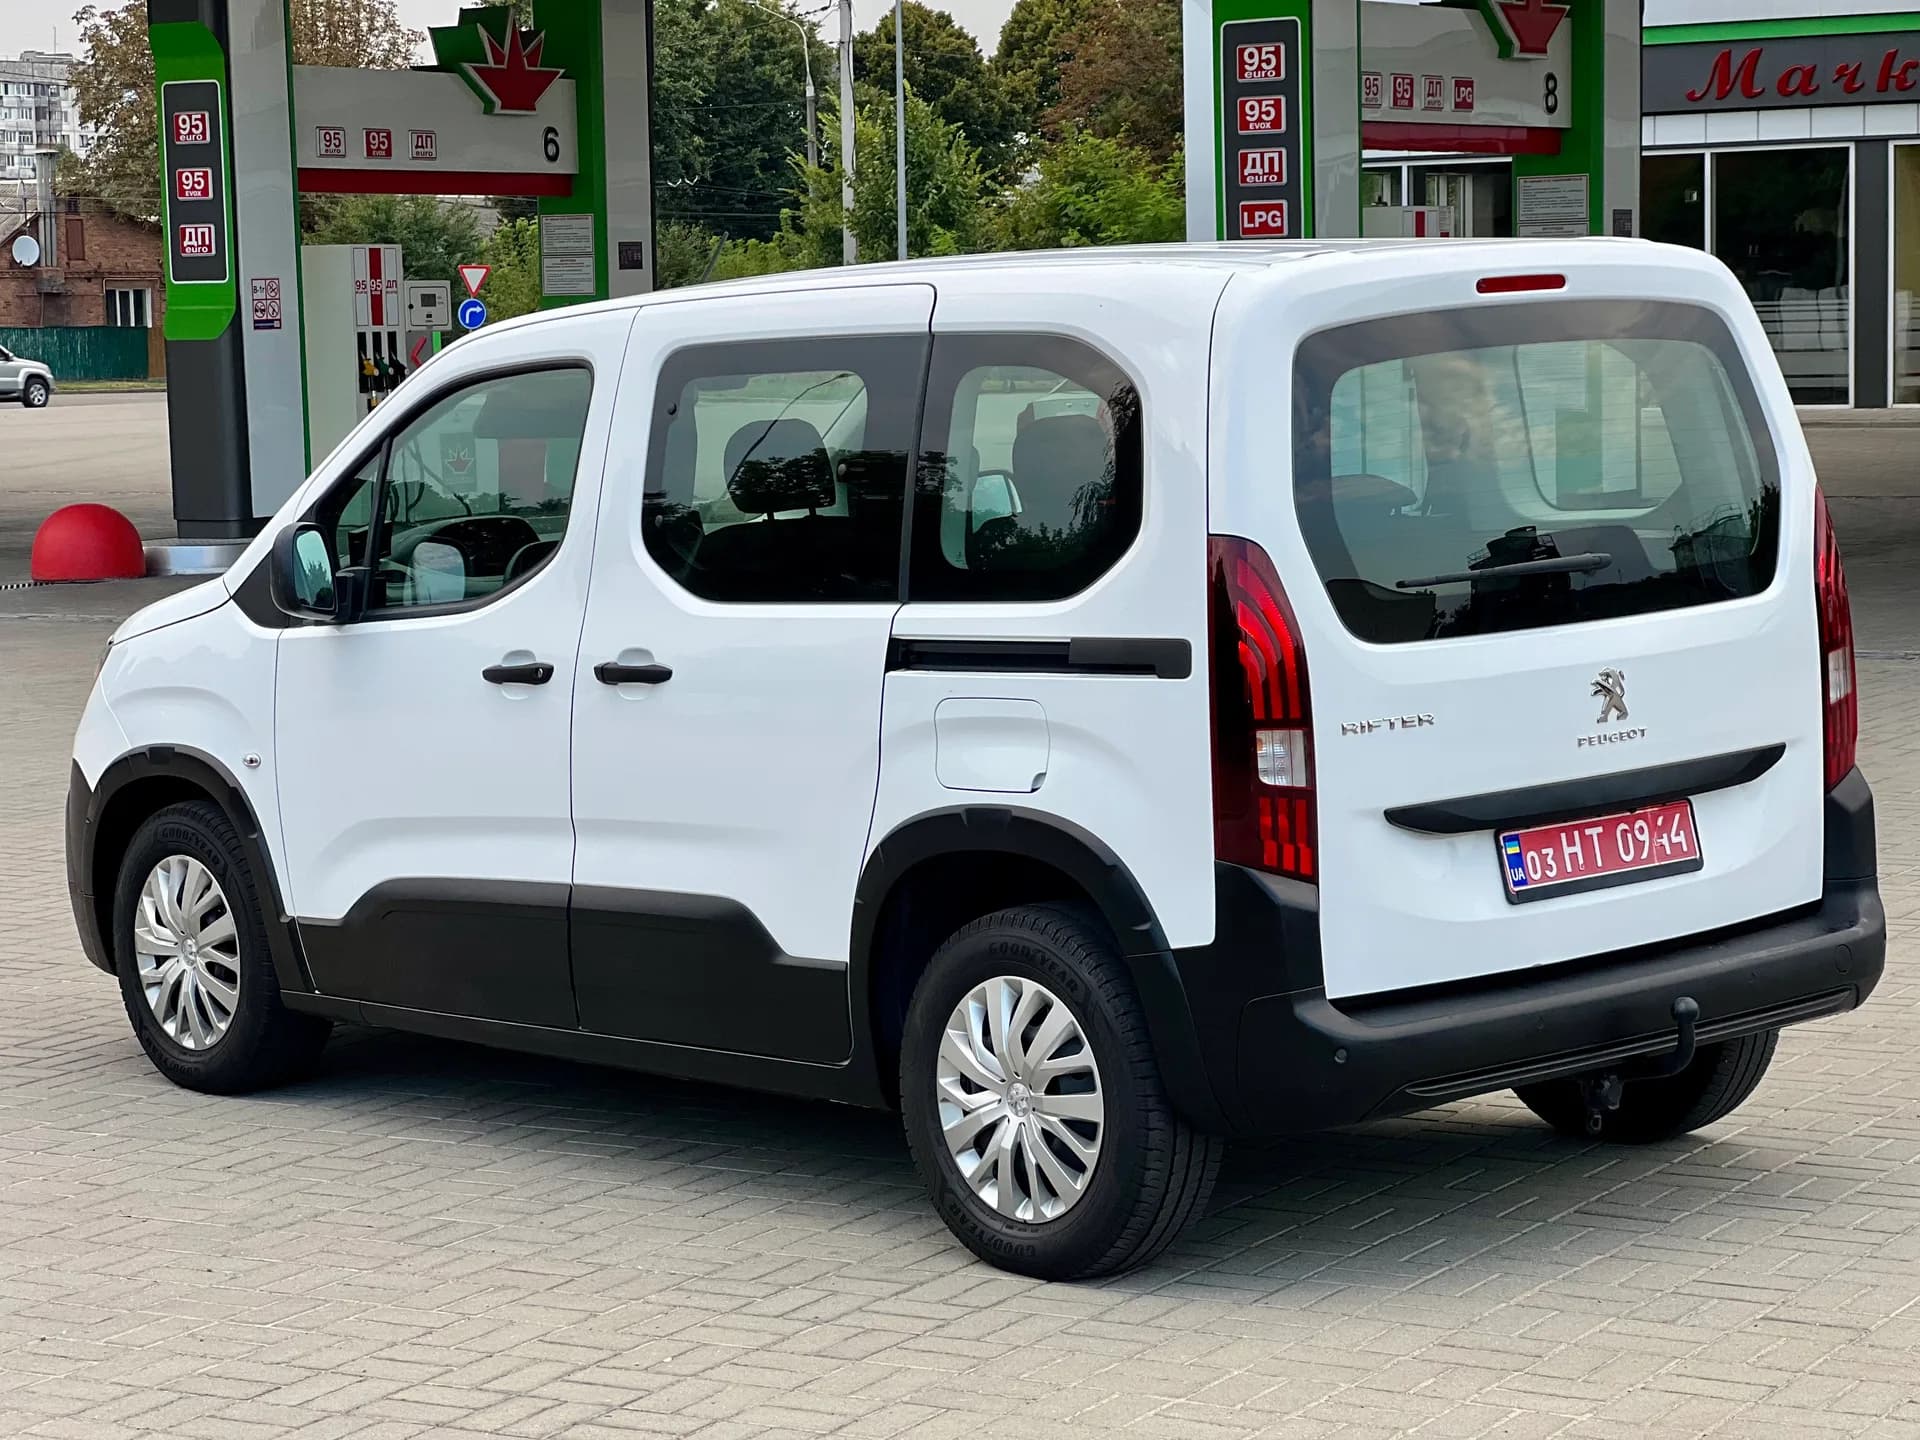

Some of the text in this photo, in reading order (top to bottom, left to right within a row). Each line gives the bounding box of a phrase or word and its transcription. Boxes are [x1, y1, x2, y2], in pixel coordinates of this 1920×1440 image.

[1243, 46, 1277, 71] 95
[1244, 70, 1276, 79] euro
[1364, 77, 1379, 96] 95
[1396, 78, 1411, 98] 95
[1427, 81, 1442, 98] ДП
[1455, 86, 1473, 103] LPG
[1543, 72, 1558, 115] 8
[1244, 100, 1276, 122] 95
[178, 115, 203, 135] 95
[1249, 122, 1272, 130] EVOX
[323, 131, 341, 148] 95
[369, 132, 388, 149] 95
[414, 135, 433, 150] ДП
[543, 126, 560, 162] 6
[1244, 152, 1280, 176] ДП
[182, 172, 205, 190] 95
[1246, 174, 1278, 183] euro
[1243, 210, 1282, 229] LPG
[184, 227, 209, 247] ДП
[355, 280, 367, 290] 95
[370, 280, 383, 291] 95
[1341, 712, 1435, 736] RIFTER
[1577, 728, 1646, 748] PEUGEOT
[1511, 867, 1526, 882] UA
[1526, 847, 1558, 881] 03
[1561, 826, 1604, 874] HT
